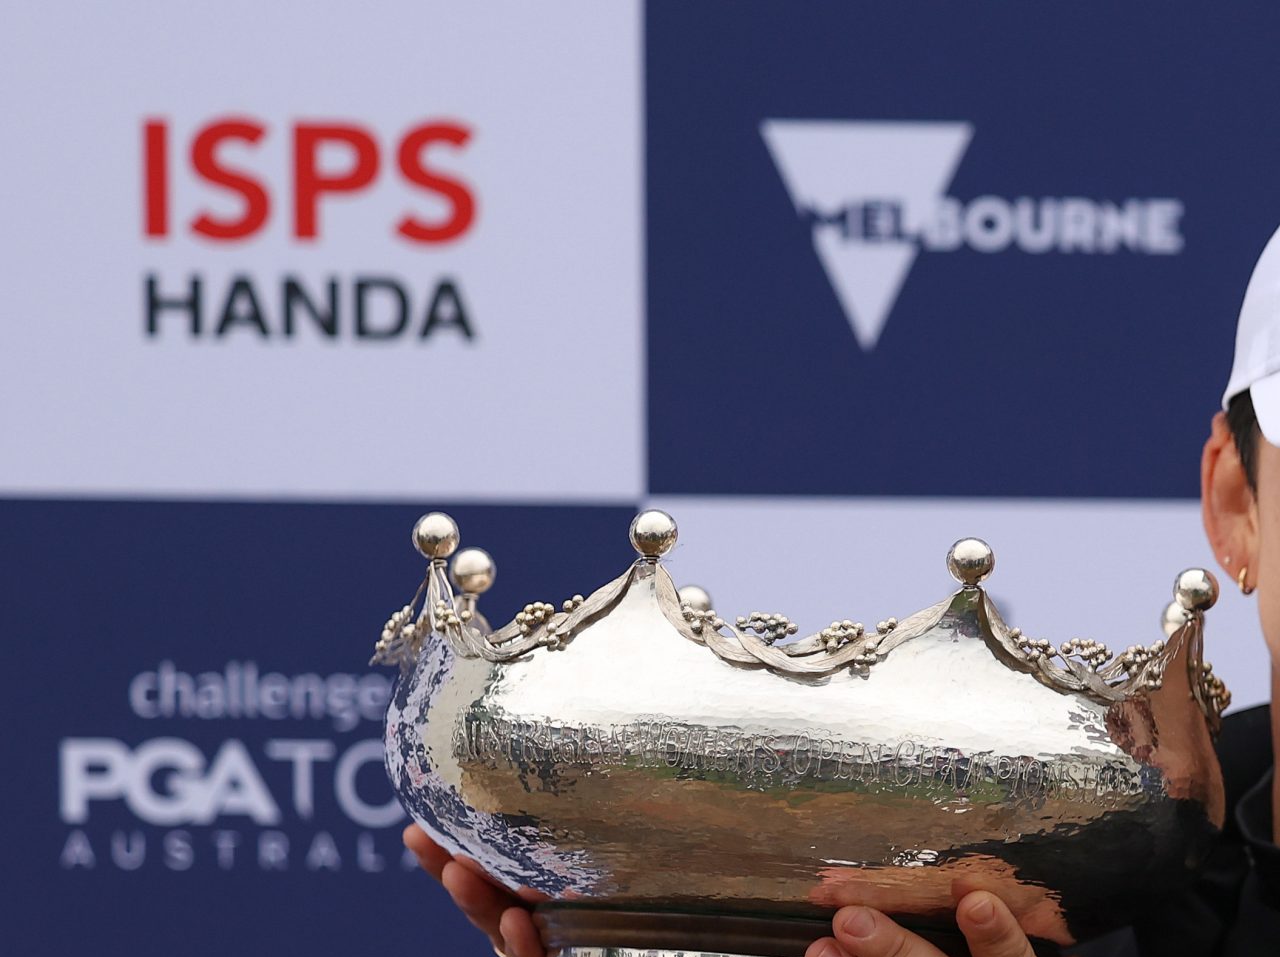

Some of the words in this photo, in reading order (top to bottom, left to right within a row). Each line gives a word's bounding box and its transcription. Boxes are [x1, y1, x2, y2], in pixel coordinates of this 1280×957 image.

[141, 116, 479, 246] ISPS
[803, 198, 1186, 253] MELBOURNE
[142, 273, 478, 342] HANDA
[60, 737, 281, 826] PGA
